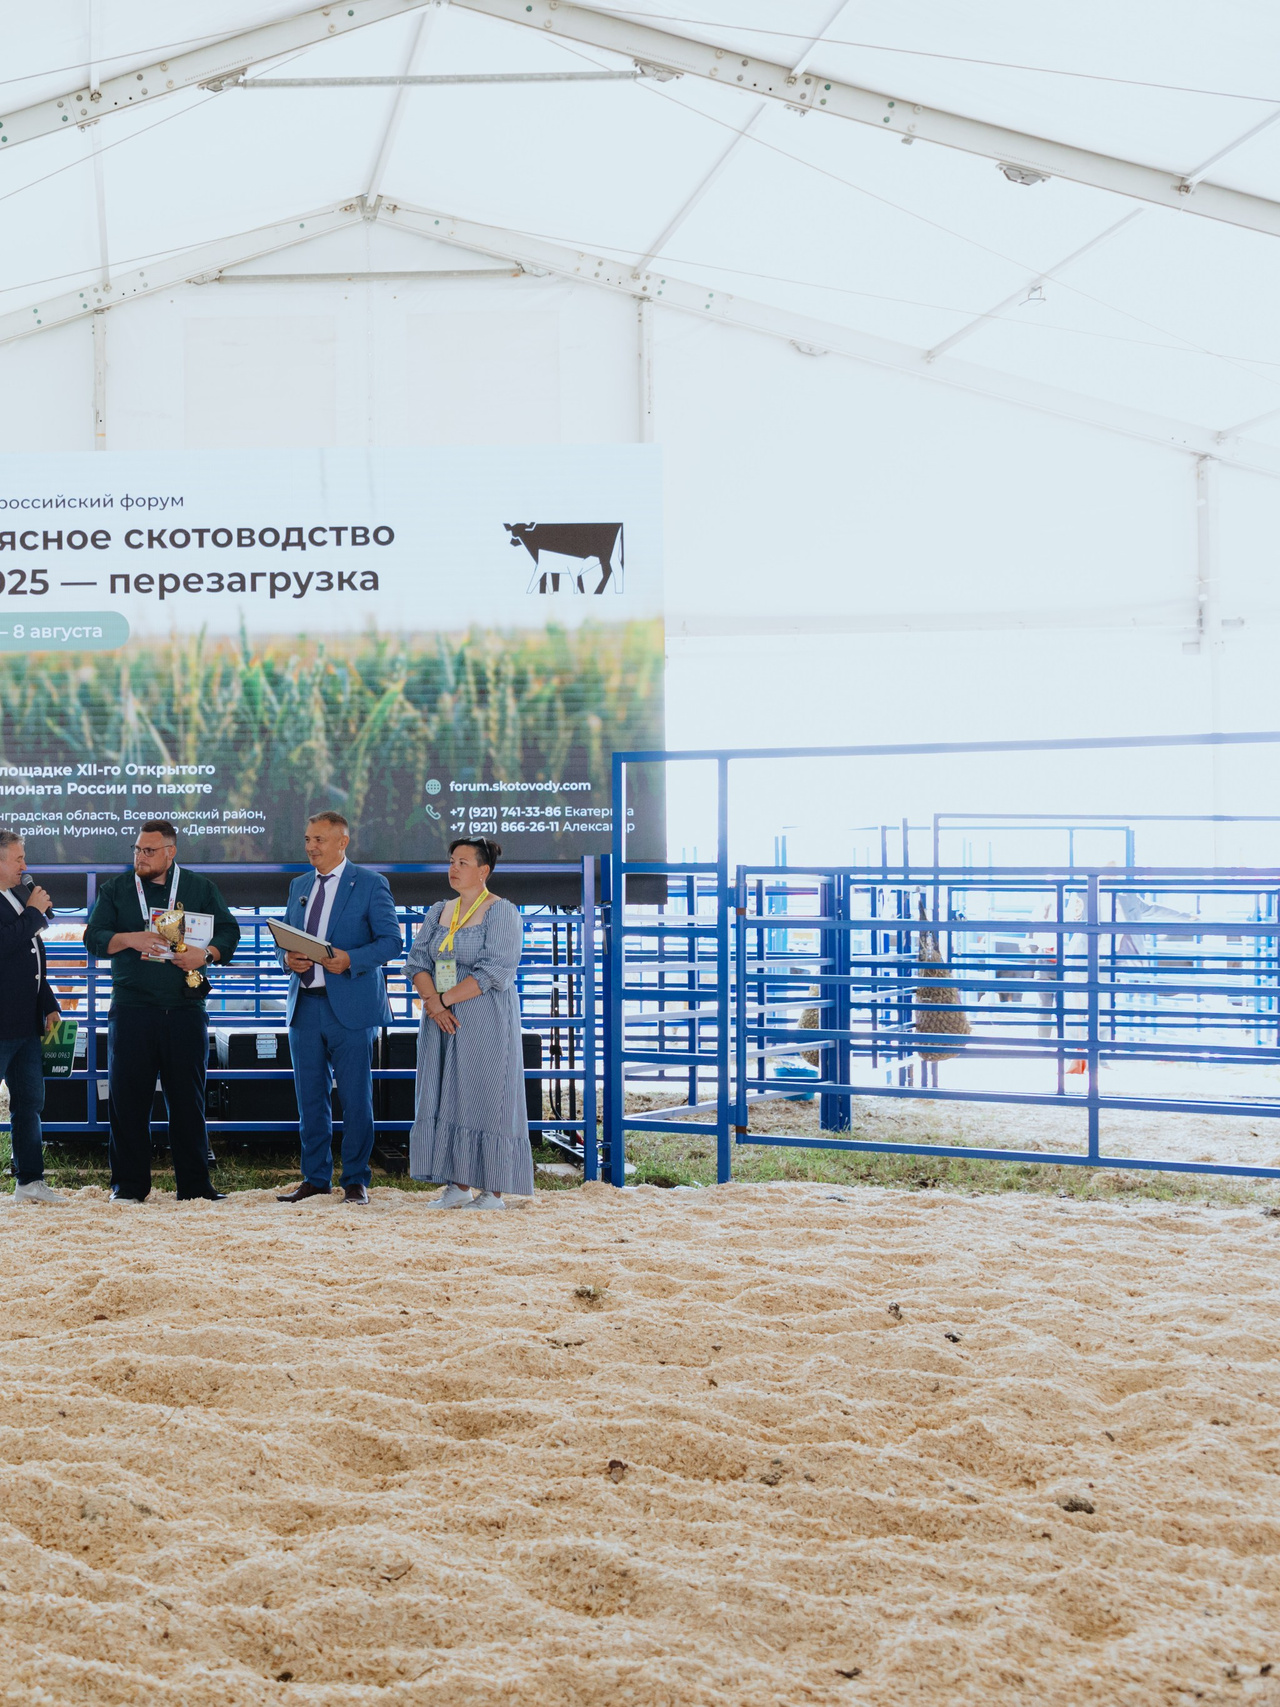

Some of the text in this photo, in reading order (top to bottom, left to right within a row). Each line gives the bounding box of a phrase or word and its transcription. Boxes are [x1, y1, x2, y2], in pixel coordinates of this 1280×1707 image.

[120, 494, 184, 511] форум
[124, 525, 395, 551] скотоводство
[110, 570, 379, 600] перезагрузка
[13, 625, 25, 639] 8
[30, 626, 103, 642] августа
[125, 763, 216, 778] Открытого
[67, 782, 127, 795] России
[132, 784, 153, 795] по
[157, 783, 213, 794] пахоте
[449, 780, 592, 793] forum.skotovody.com
[66, 809, 120, 822] область,
[123, 808, 220, 820] Всеволожский
[223, 808, 267, 820] район,
[450, 806, 635, 819] +7 (921) 741-33-86 Екатера
[20, 825, 60, 838] район
[63, 825, 118, 838] Мурино,
[120, 827, 137, 836] ст.
[182, 824, 266, 836] «Девяткино»
[450, 821, 636, 834] +7 (921) 866-26-11 Алексар
[51, 1065, 68, 1073] МИР
